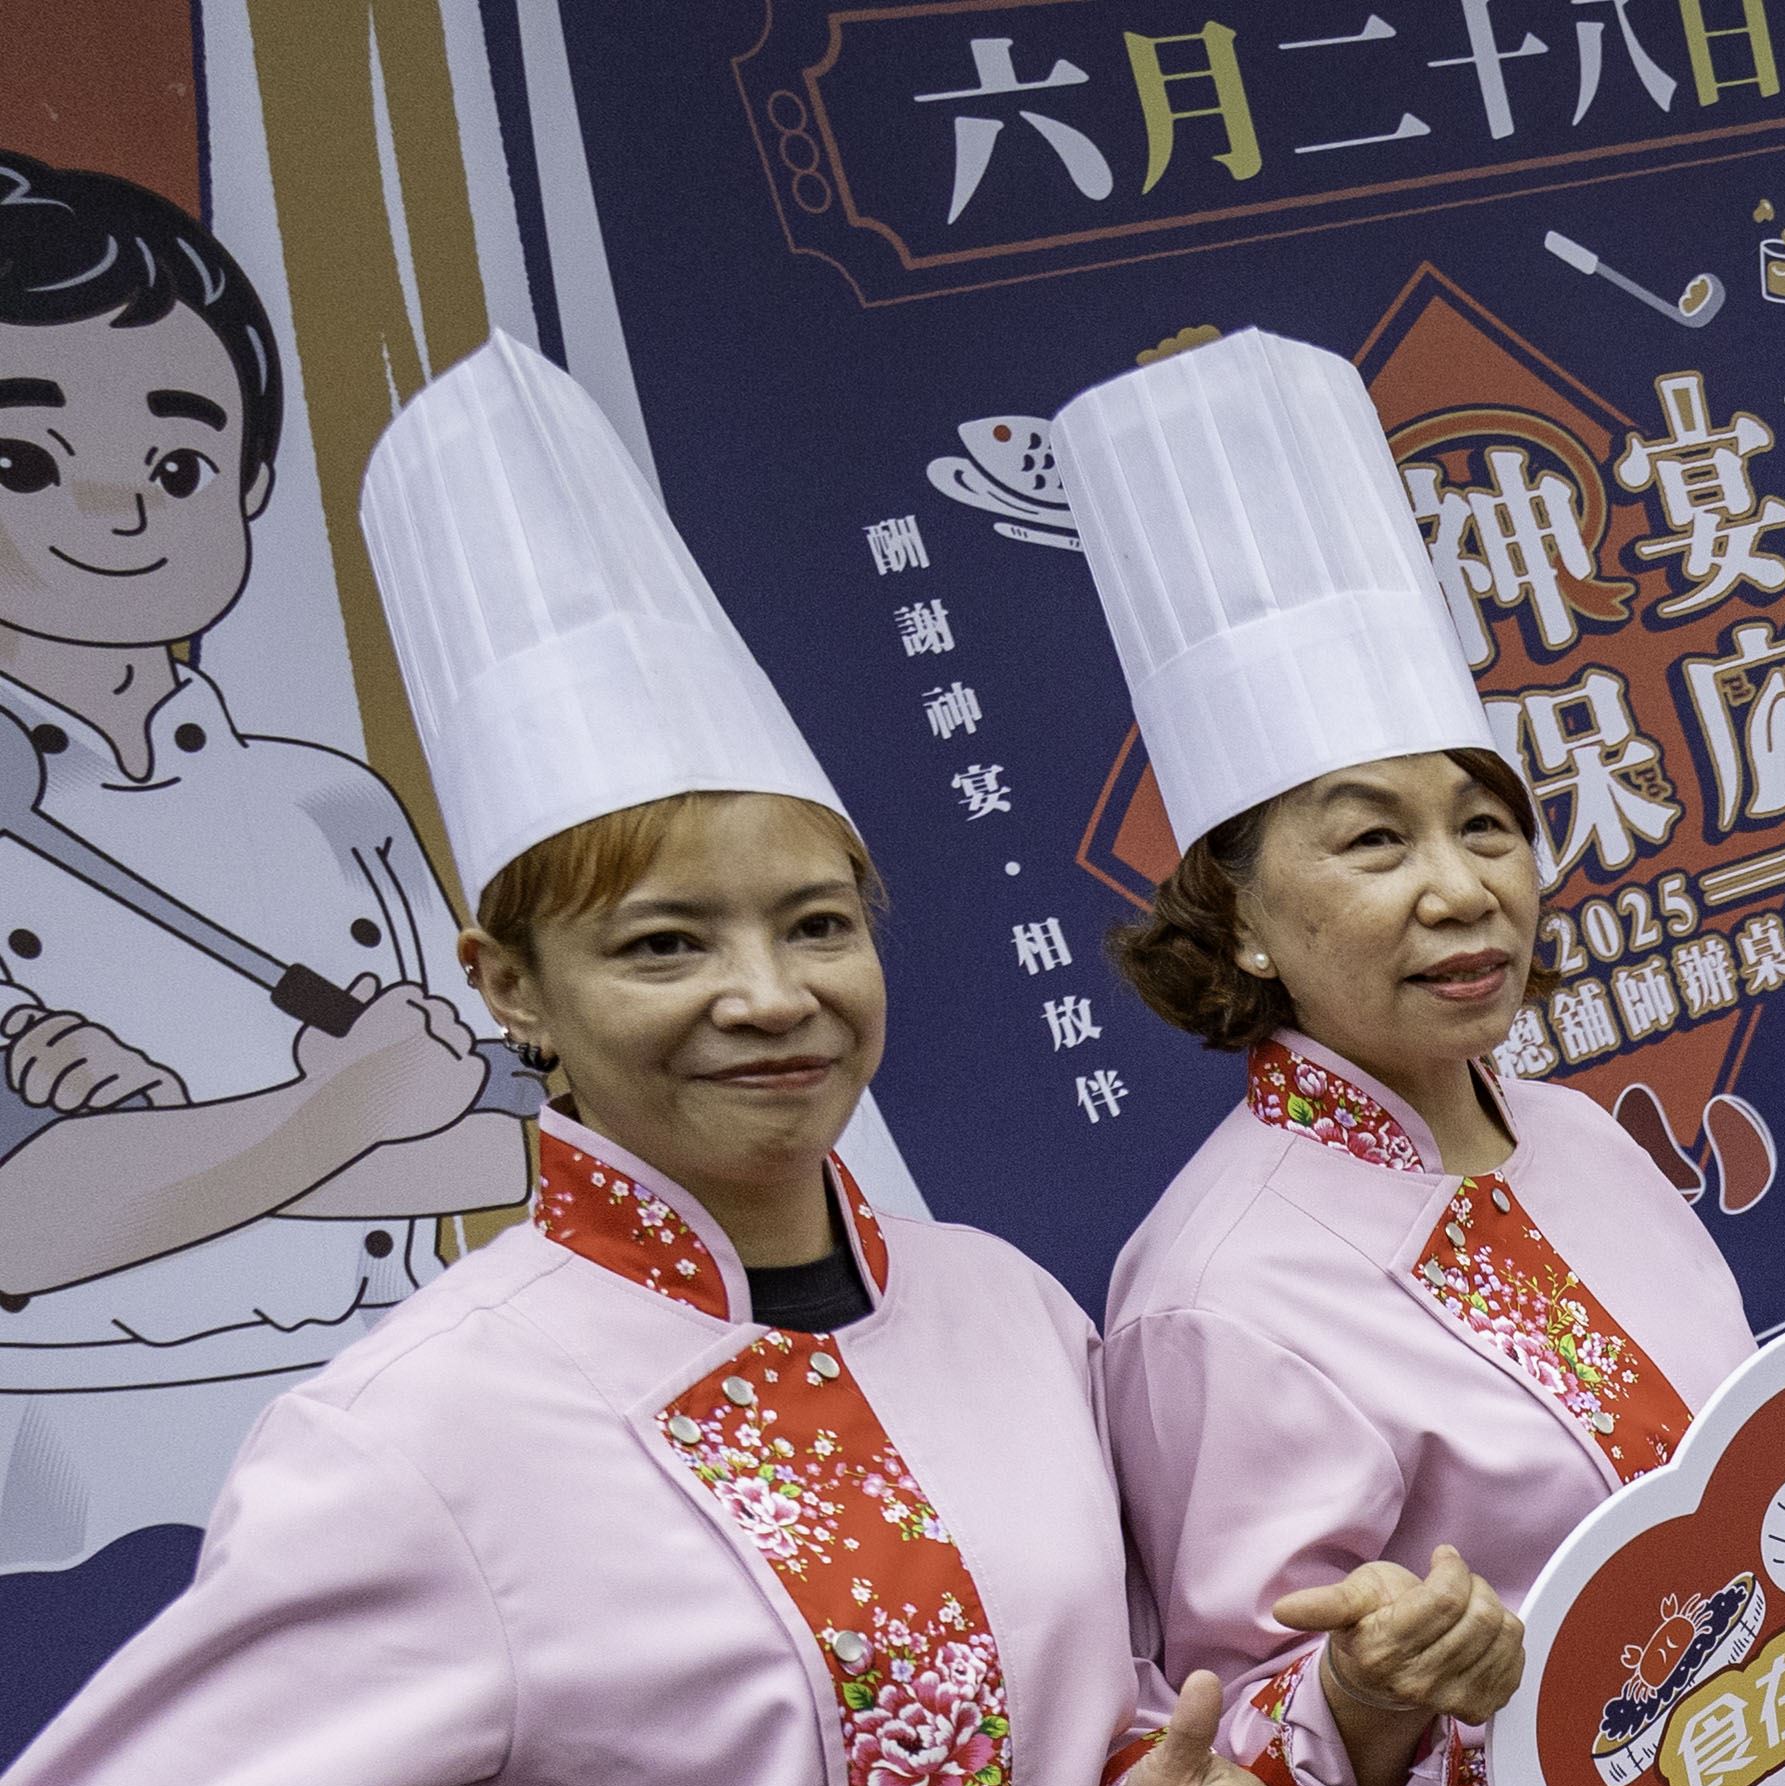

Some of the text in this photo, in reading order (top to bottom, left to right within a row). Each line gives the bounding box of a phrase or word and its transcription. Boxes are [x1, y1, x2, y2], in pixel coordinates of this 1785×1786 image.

[914, 0, 1782, 226] 六月二十八日
[1541, 872, 1698, 978] 2025
